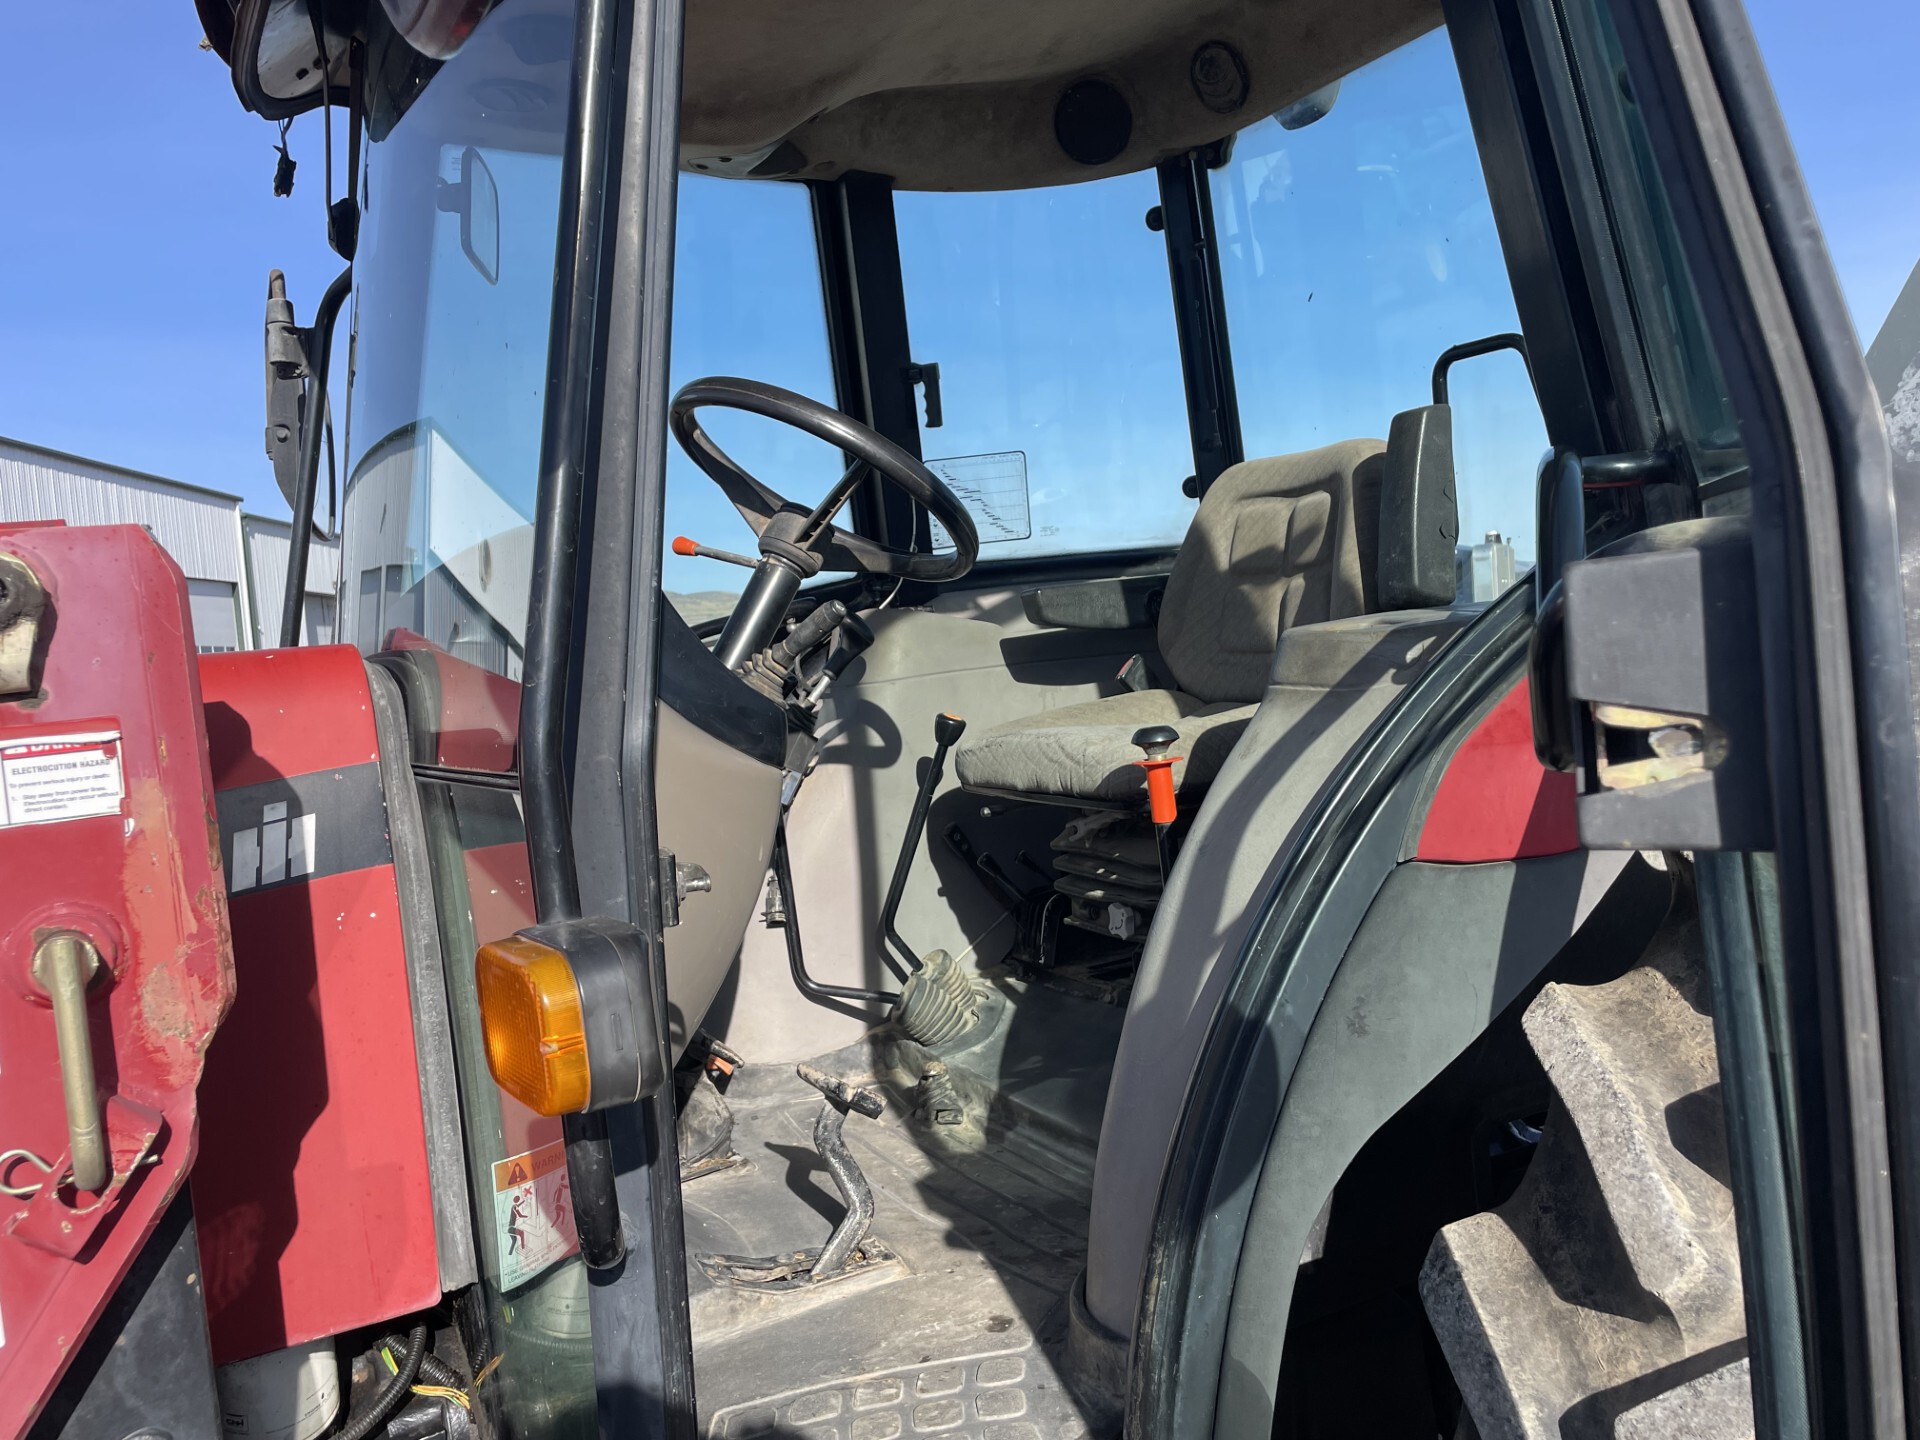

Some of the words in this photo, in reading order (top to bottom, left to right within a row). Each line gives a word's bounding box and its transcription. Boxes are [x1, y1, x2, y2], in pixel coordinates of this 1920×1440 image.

[12, 763, 77, 776] ELECTROCUTION
[80, 759, 110, 768] HAZARD
[18, 781, 42, 789] prevent
[24, 798, 65, 806] Electrocution
[531, 1150, 564, 1170] WARNI
